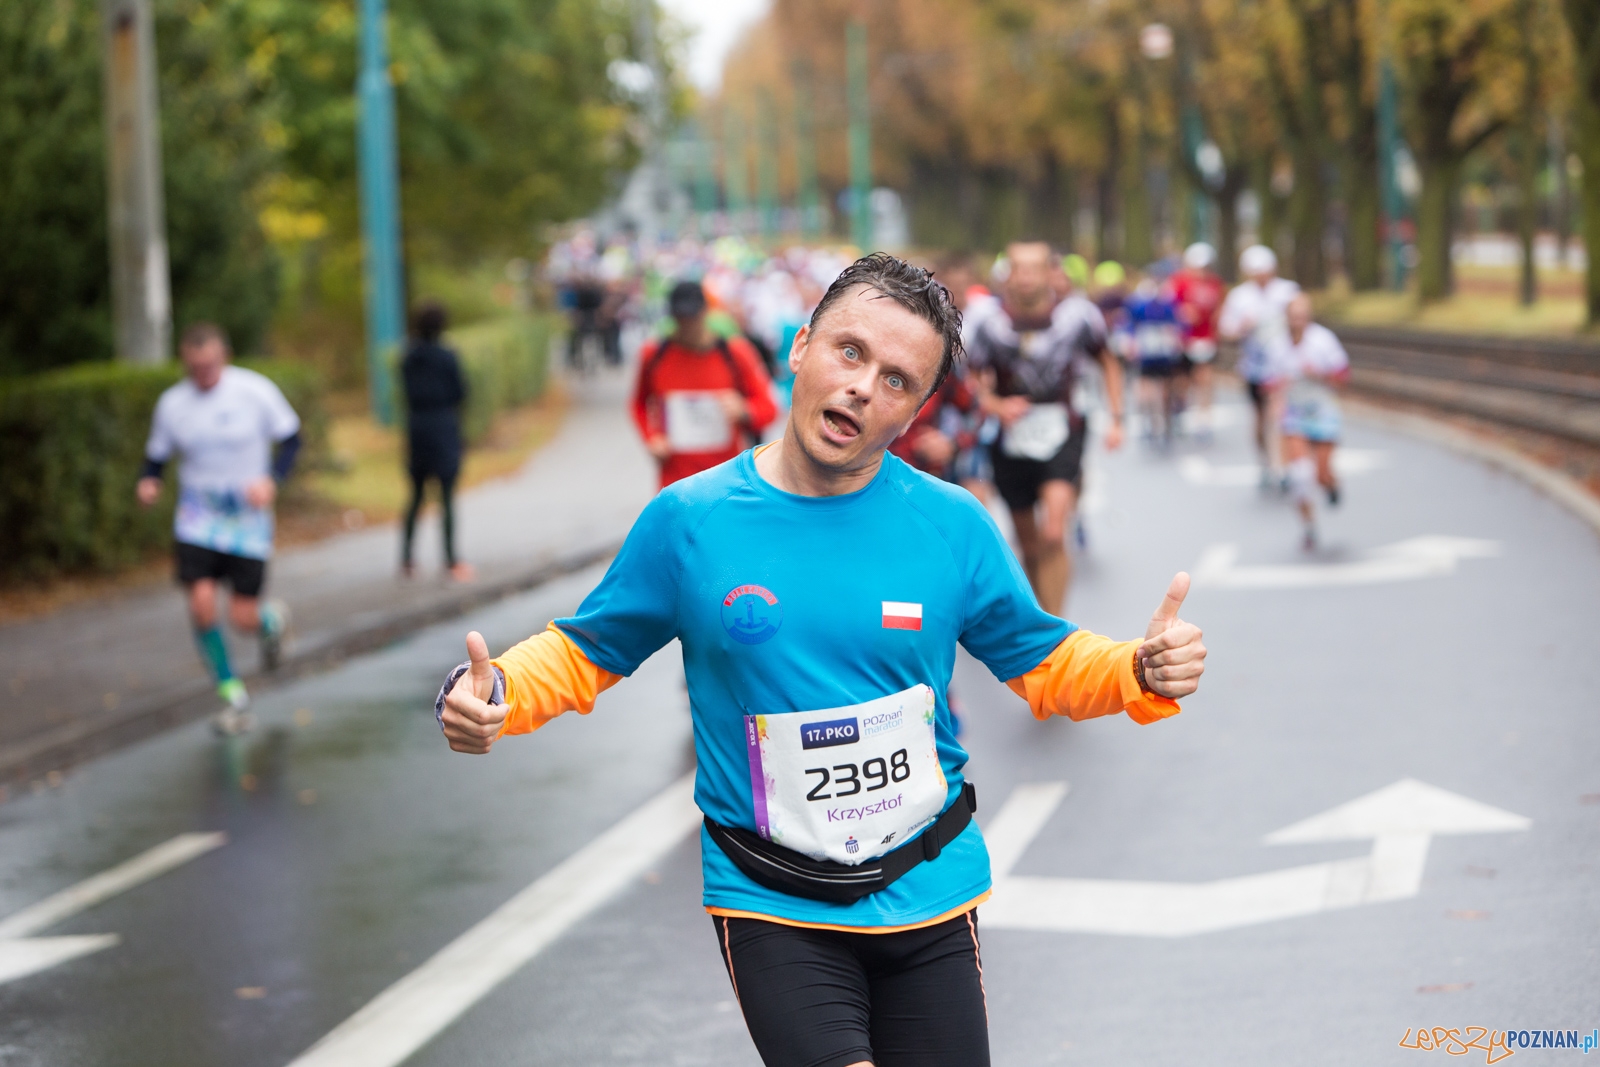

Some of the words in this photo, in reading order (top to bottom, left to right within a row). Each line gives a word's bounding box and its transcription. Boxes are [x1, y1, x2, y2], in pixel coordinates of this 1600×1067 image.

[826, 725, 855, 741] PKO
[864, 718, 903, 736] maraton
[804, 748, 911, 802] 2398
[827, 793, 903, 822] Krzysztof
